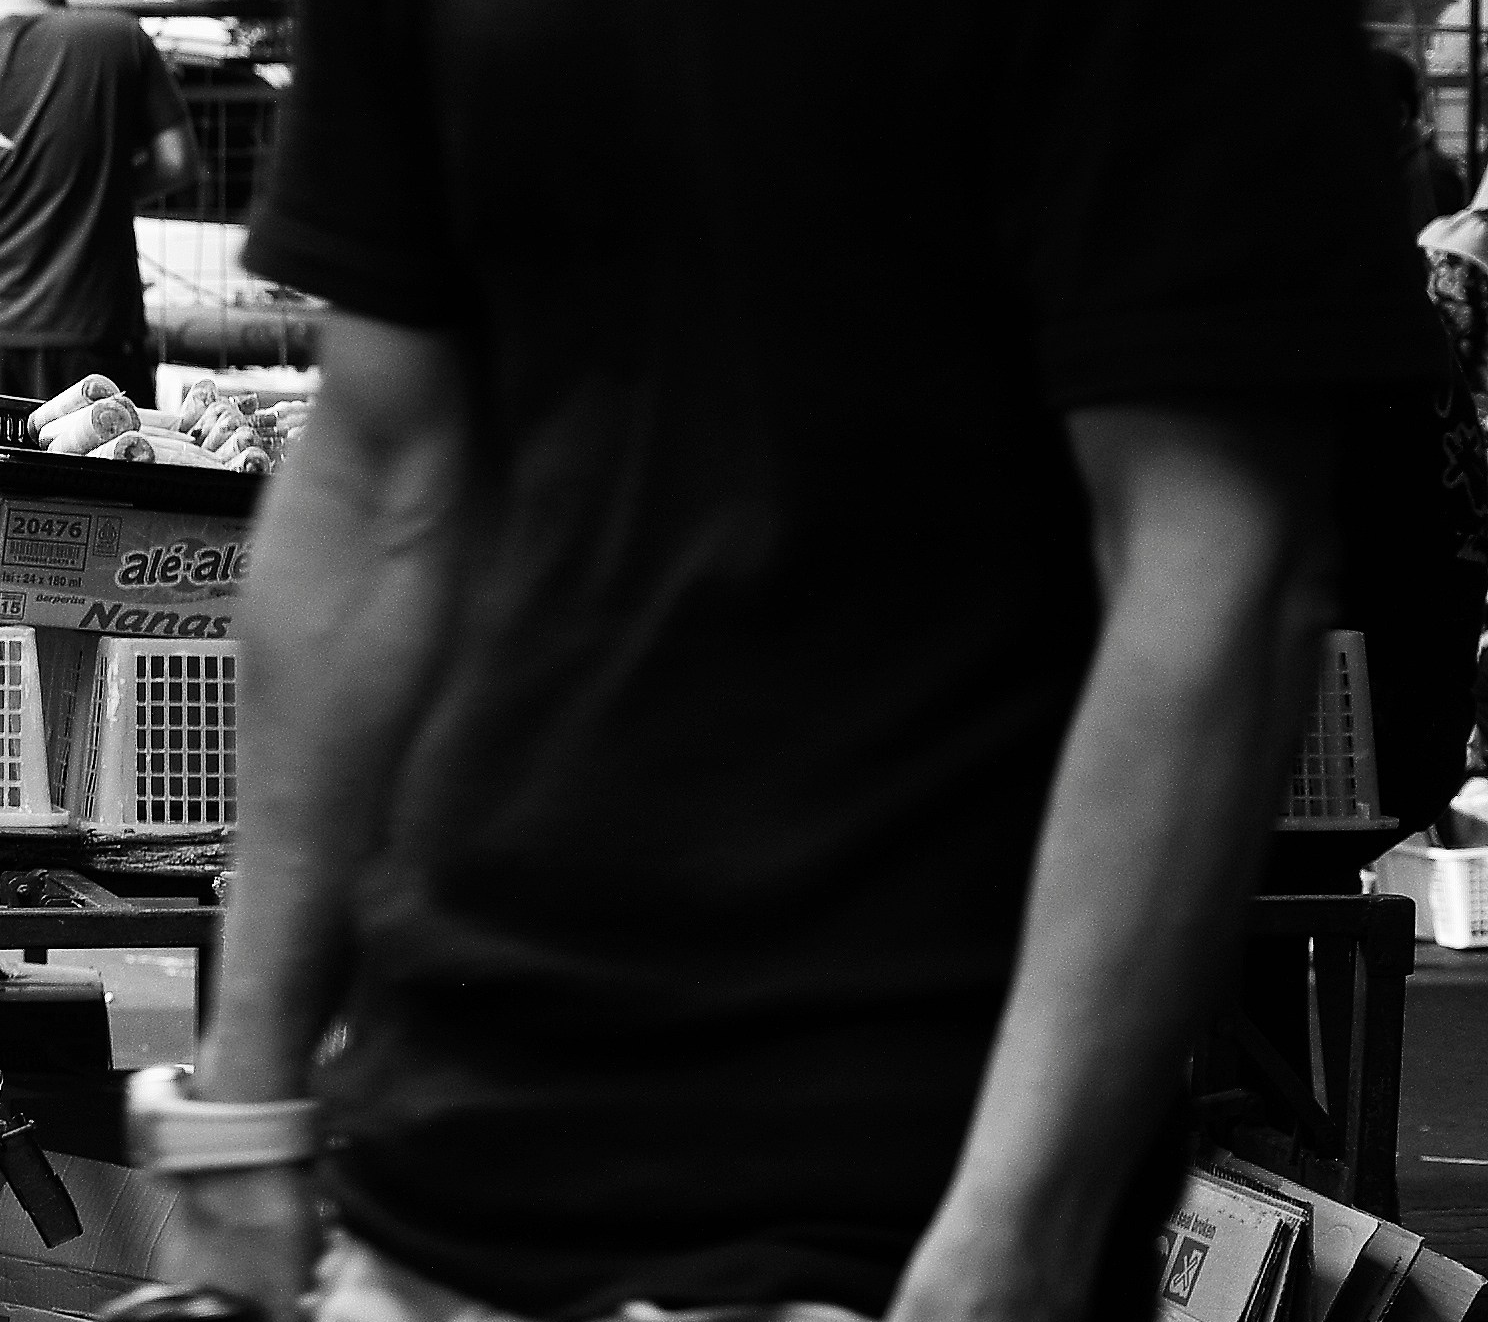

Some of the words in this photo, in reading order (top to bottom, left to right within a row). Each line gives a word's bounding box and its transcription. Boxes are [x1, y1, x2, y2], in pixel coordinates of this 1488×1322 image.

[11, 515, 83, 539] 20476
[21, 573, 36, 586] 24
[47, 575, 66, 588] 180
[68, 577, 83, 589] ml
[0, 600, 20, 615] 15
[78, 600, 232, 639] Nanas
